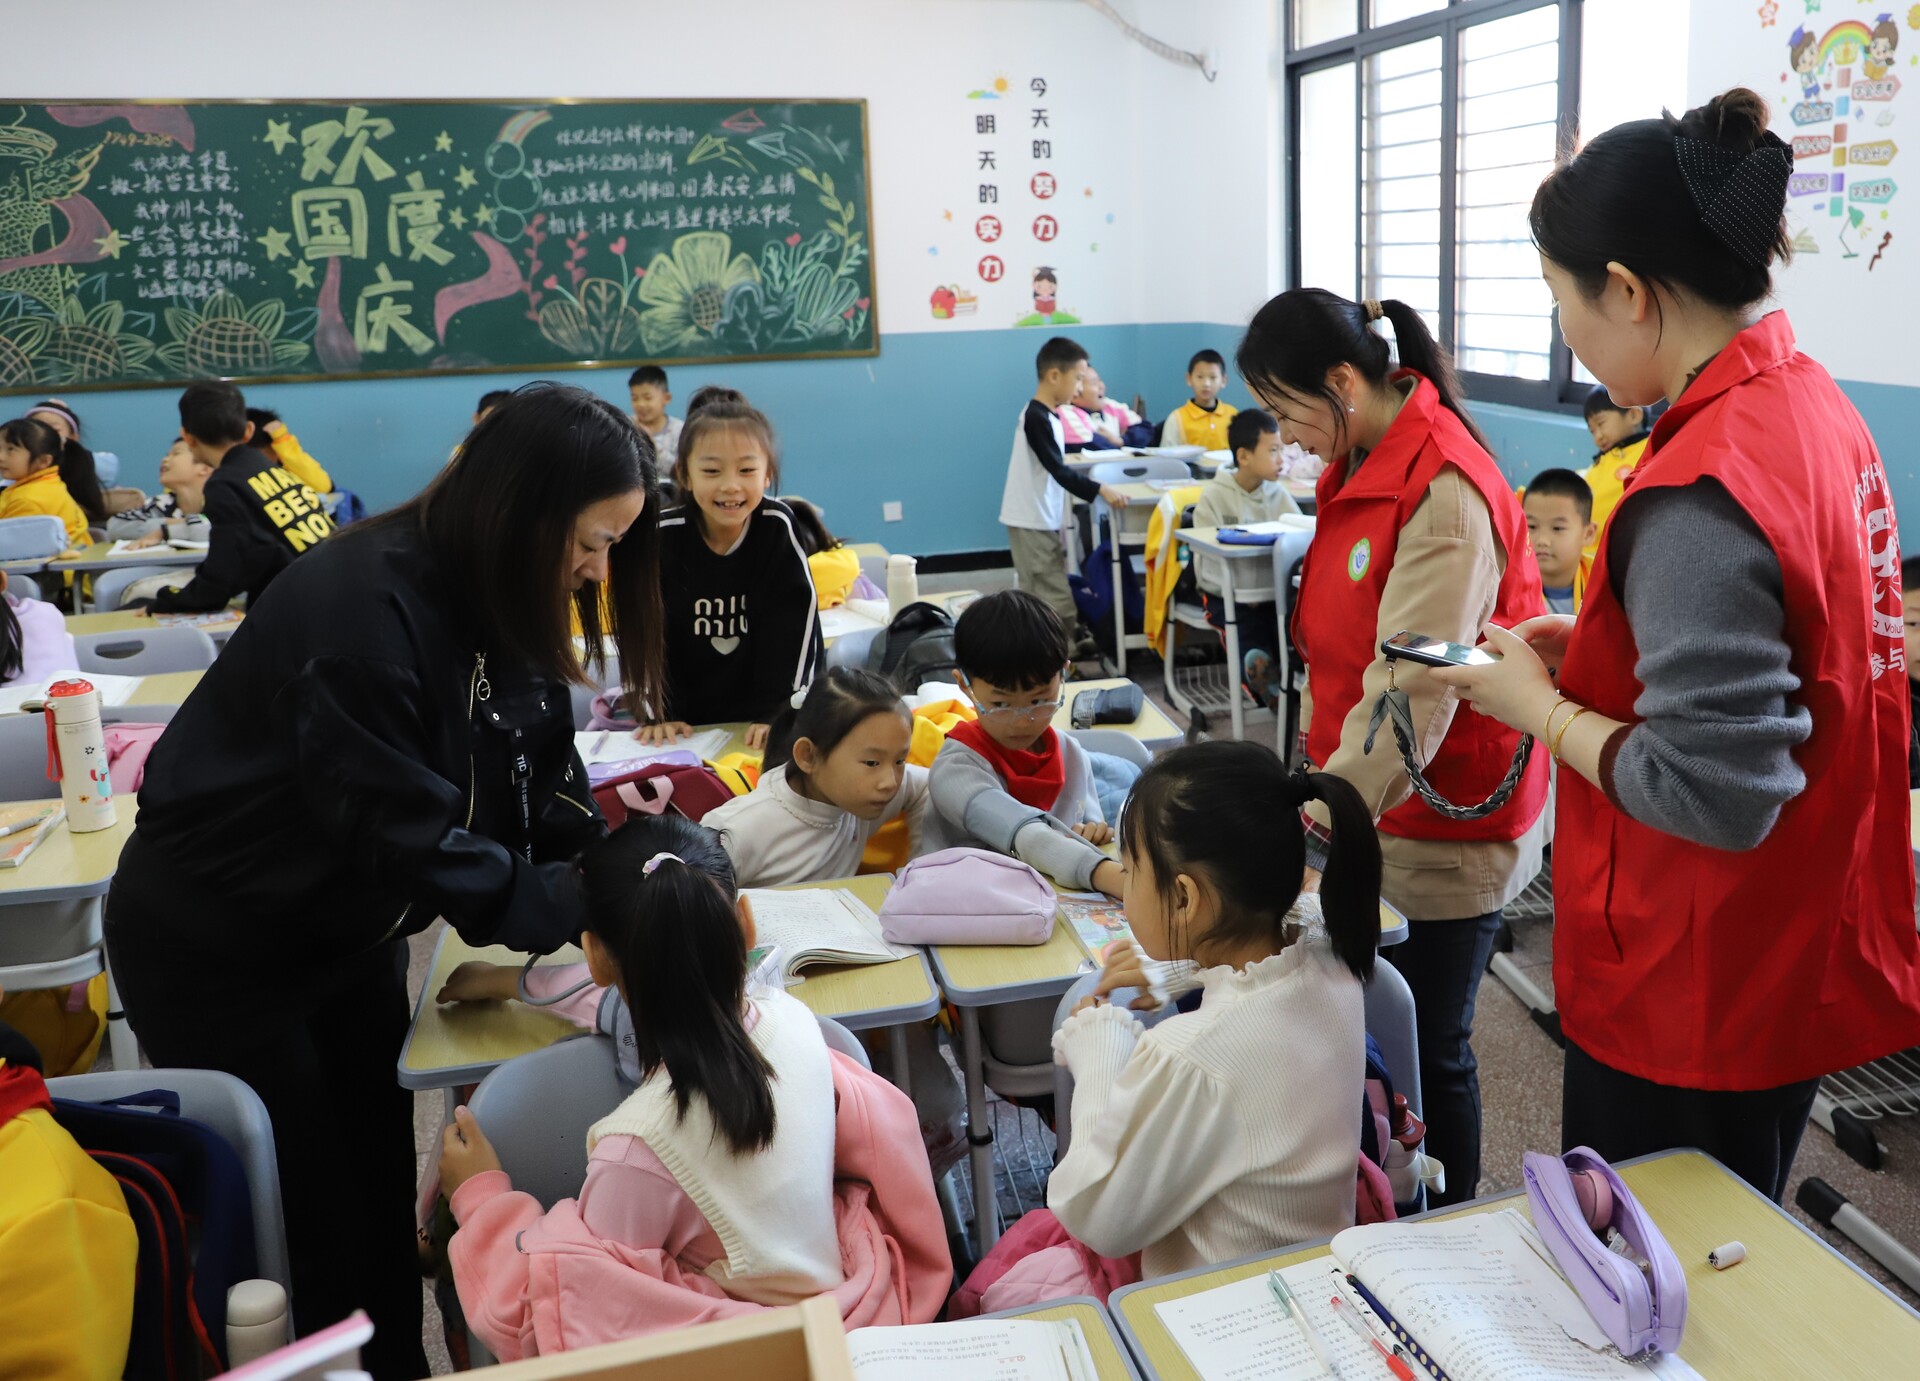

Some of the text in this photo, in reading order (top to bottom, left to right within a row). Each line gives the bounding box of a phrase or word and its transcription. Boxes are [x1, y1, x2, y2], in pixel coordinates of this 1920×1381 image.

[976, 113, 1003, 281] 明天的实力
[1030, 77, 1057, 240] 今天的努力
[263, 485, 320, 529] BES
